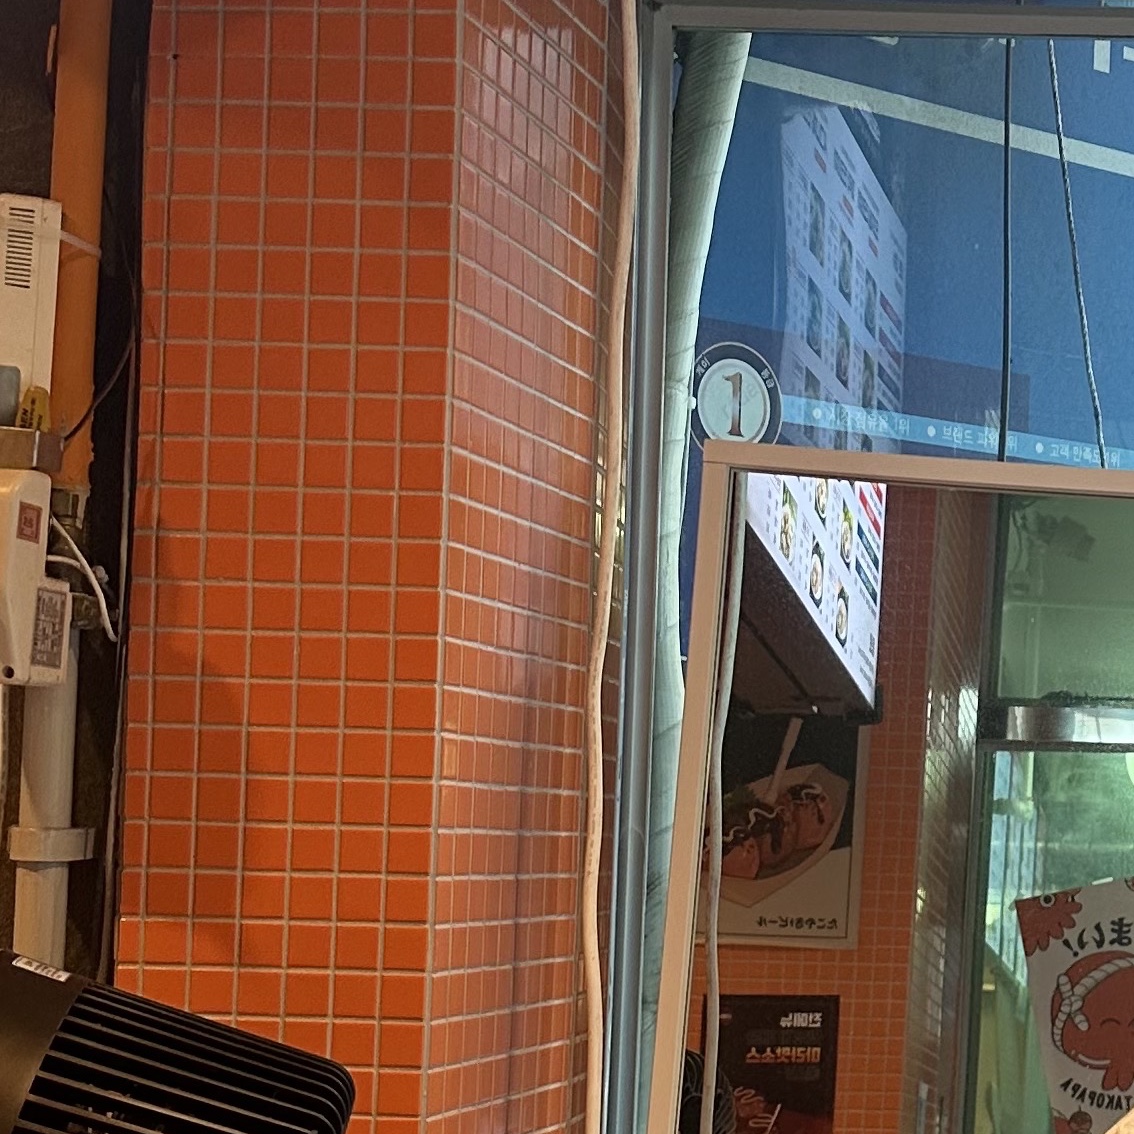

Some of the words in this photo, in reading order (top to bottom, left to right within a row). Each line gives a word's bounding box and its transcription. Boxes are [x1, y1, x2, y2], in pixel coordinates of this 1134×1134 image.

[722, 371, 745, 438] 1
[942, 426, 974, 445] 브랜드
[1050, 443, 1070, 460] 고객
